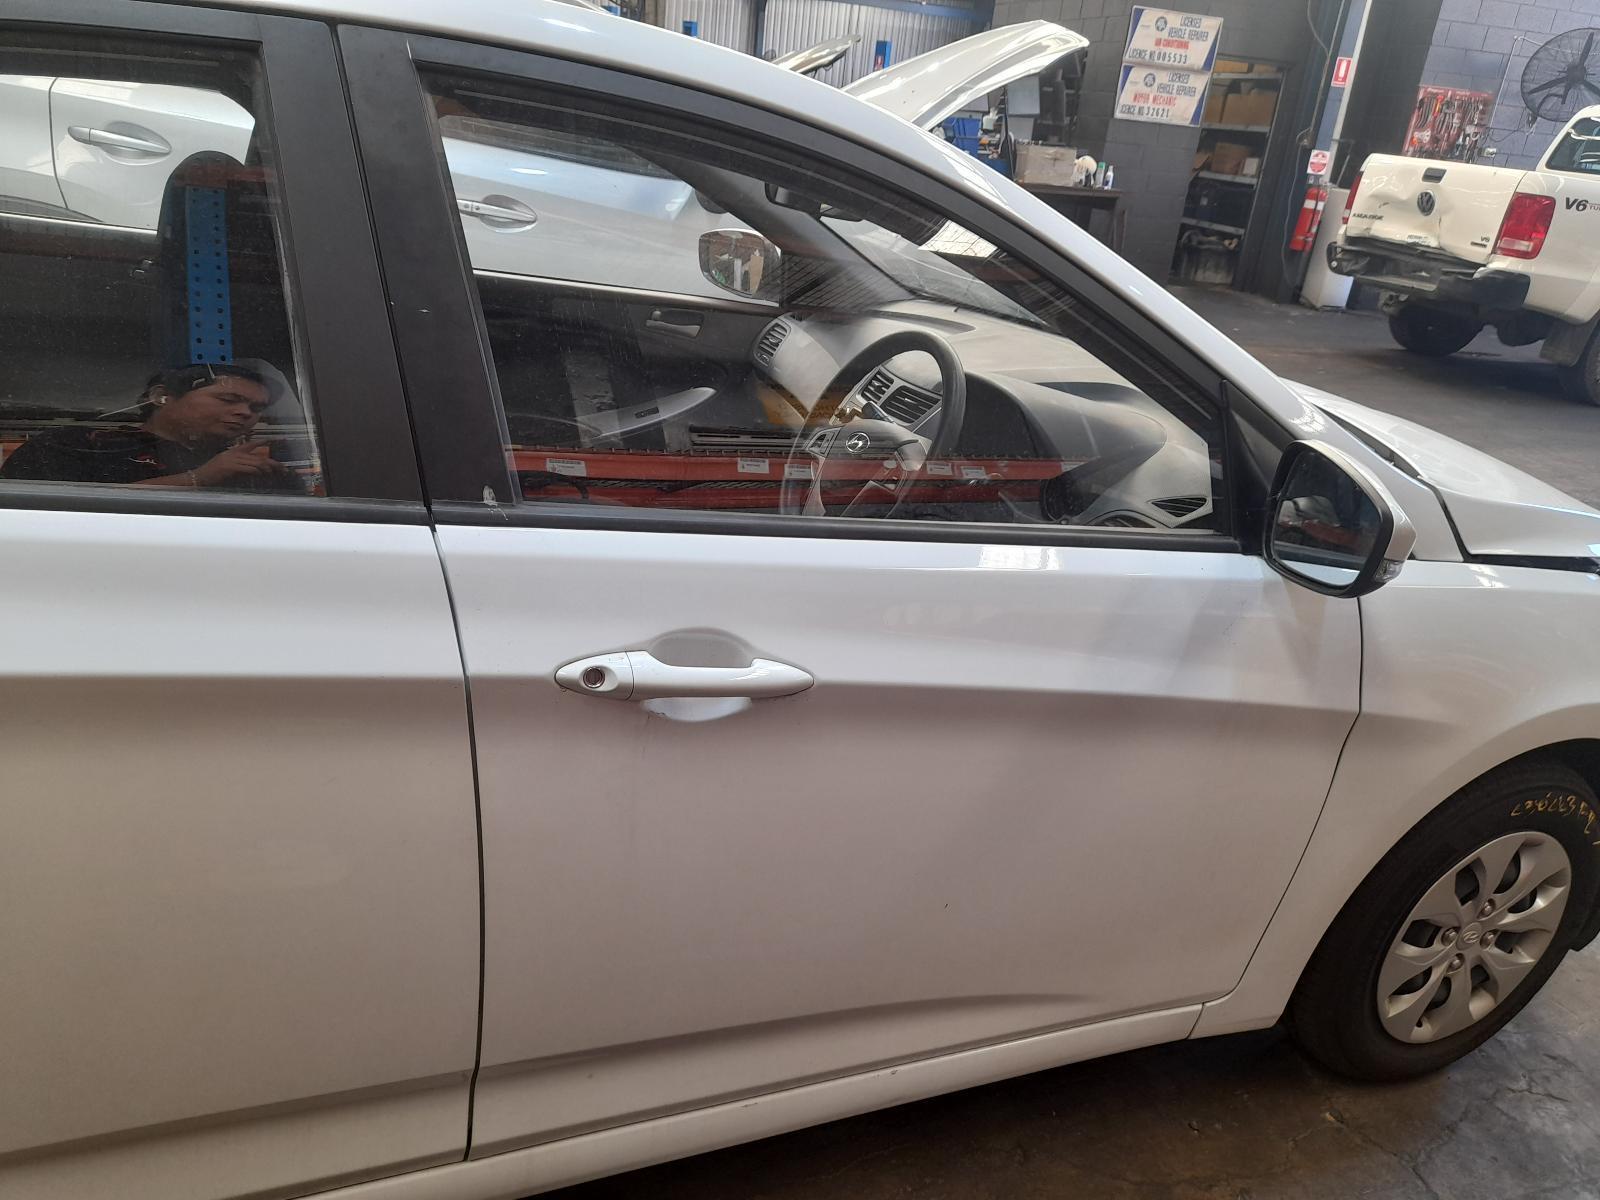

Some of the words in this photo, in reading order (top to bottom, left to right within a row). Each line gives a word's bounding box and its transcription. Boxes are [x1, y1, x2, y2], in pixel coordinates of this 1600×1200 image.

[1168, 27, 1186, 39] VEHICLE
[1188, 30, 1208, 41] REPAIRER
[1156, 52, 1187, 63] 005533
[1157, 84, 1175, 95] VEHICLE
[1176, 85, 1196, 97] REPAIRER
[1152, 93, 1176, 106] MECHANIC
[1145, 106, 1169, 118] 32621
[1565, 197, 1589, 212] V6
